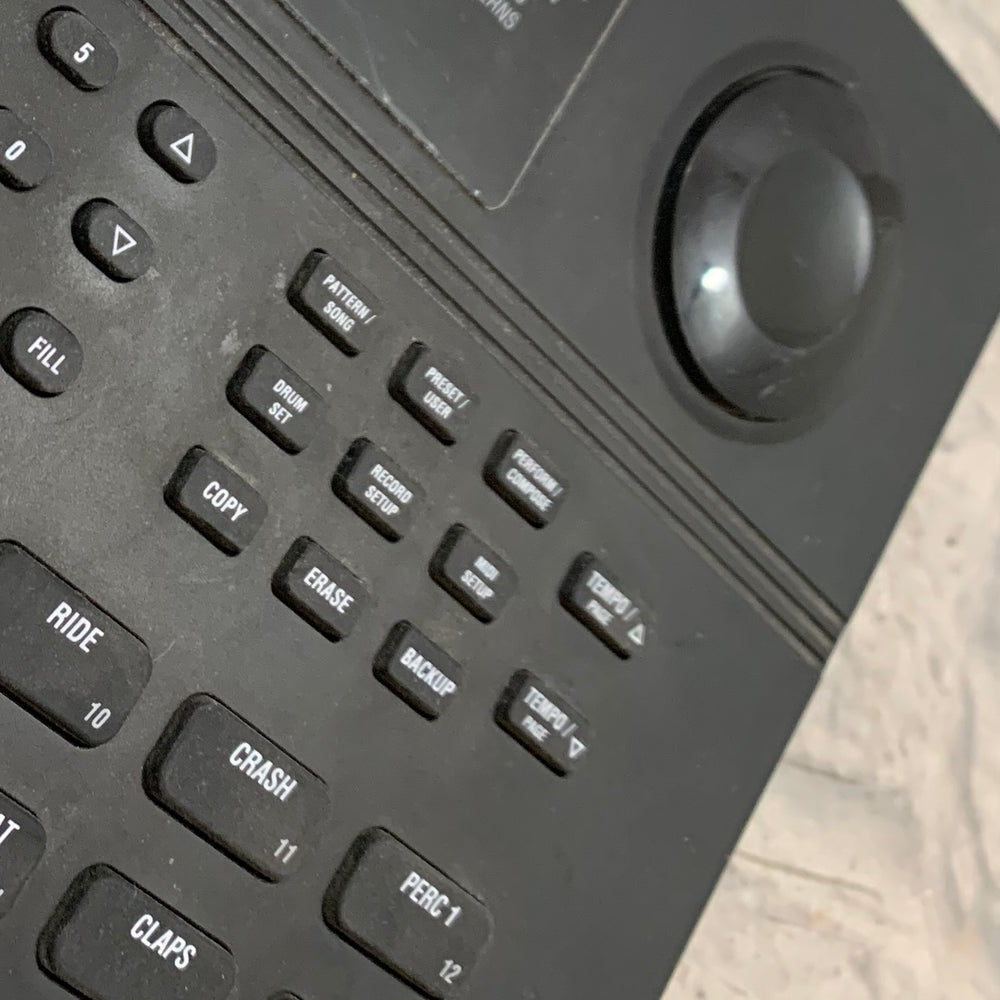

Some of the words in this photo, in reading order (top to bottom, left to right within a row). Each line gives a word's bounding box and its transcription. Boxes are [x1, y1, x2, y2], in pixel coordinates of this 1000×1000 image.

[73, 42, 95, 64] 5
[4, 140, 27, 161] 0
[322, 273, 377, 324] PATTERN/
[323, 301, 355, 331] SONG
[27, 336, 66, 376] FILL
[272, 378, 309, 413] DRUM
[423, 390, 453, 419] USER
[424, 366, 470, 409] PRESET/
[268, 401, 293, 424] SET
[202, 480, 249, 522] COPY
[364, 485, 400, 516] SETUP
[370, 463, 414, 504] RECORD
[303, 567, 355, 614] ERASE
[460, 569, 495, 599] SETUP
[46, 601, 105, 653] RIDE
[400, 647, 457, 697] BACKUP
[83, 702, 112, 729] 10
[229, 742, 298, 801] CRASH
[273, 838, 298, 864] 11
[399, 871, 448, 918] PERC
[443, 905, 462, 927] 1
[130, 914, 197, 970] CLAPS
[439, 959, 462, 984] 12
